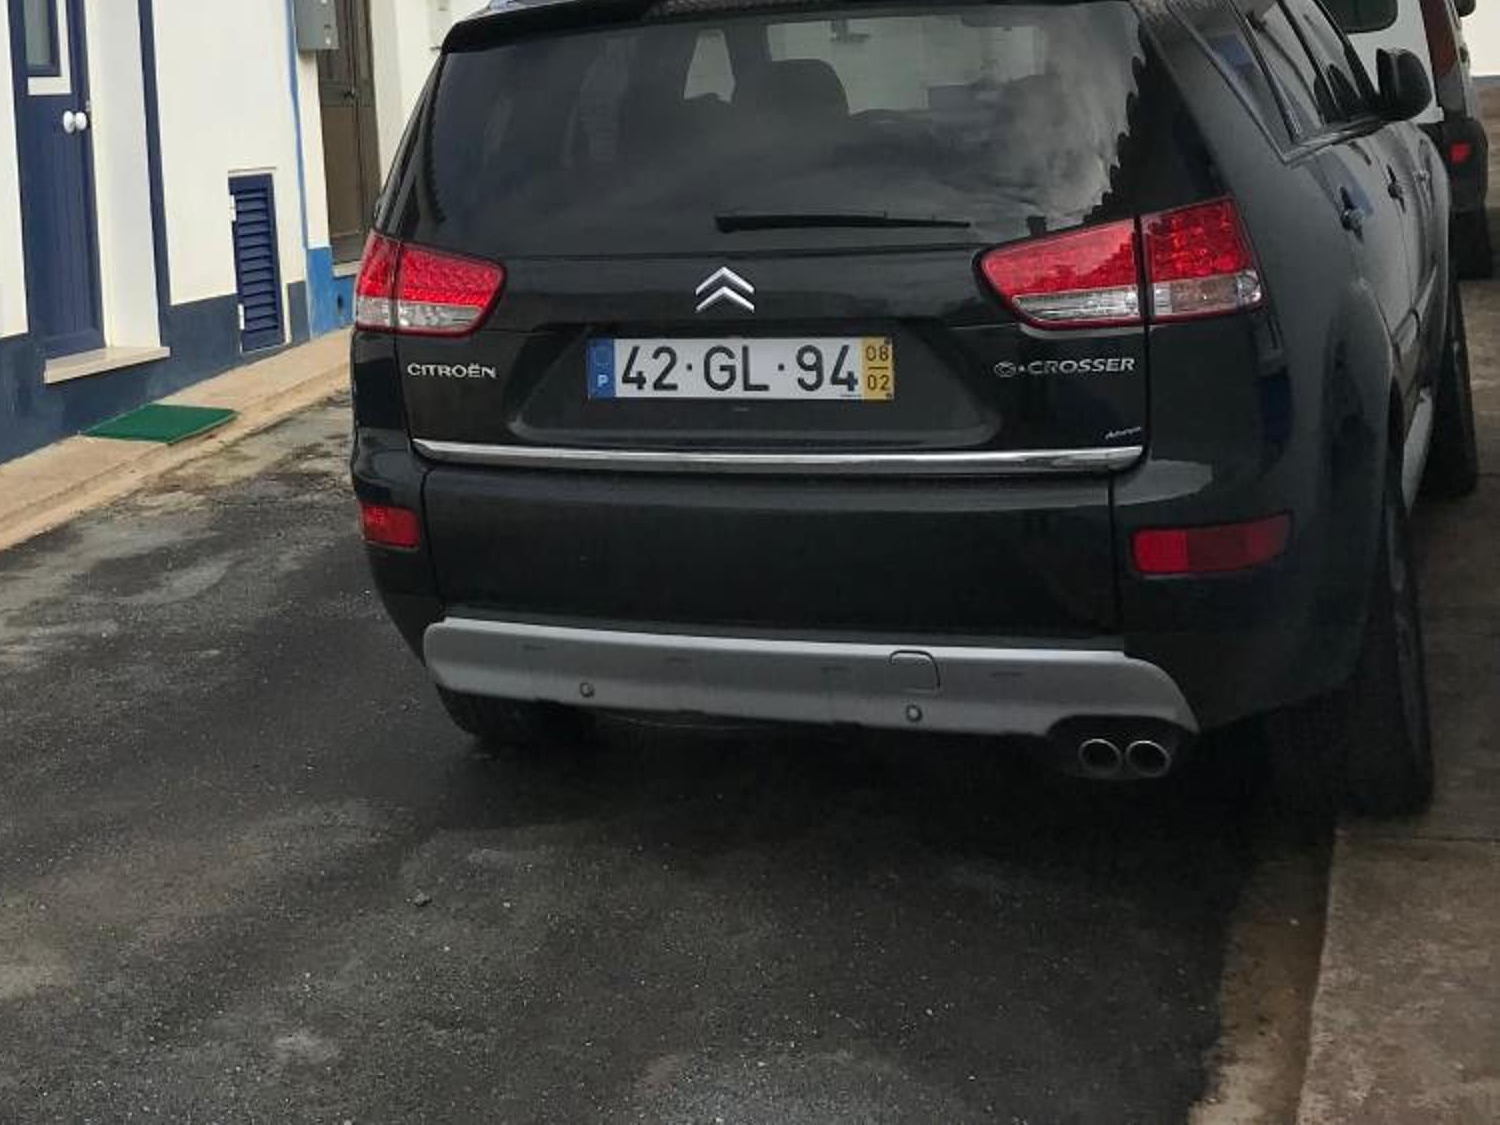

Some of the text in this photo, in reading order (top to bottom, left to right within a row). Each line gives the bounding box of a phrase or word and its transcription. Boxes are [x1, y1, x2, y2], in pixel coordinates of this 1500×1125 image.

[865, 344, 890, 363] 08
[407, 362, 498, 379] CITROËN
[597, 374, 608, 388] P
[866, 374, 890, 391] 02
